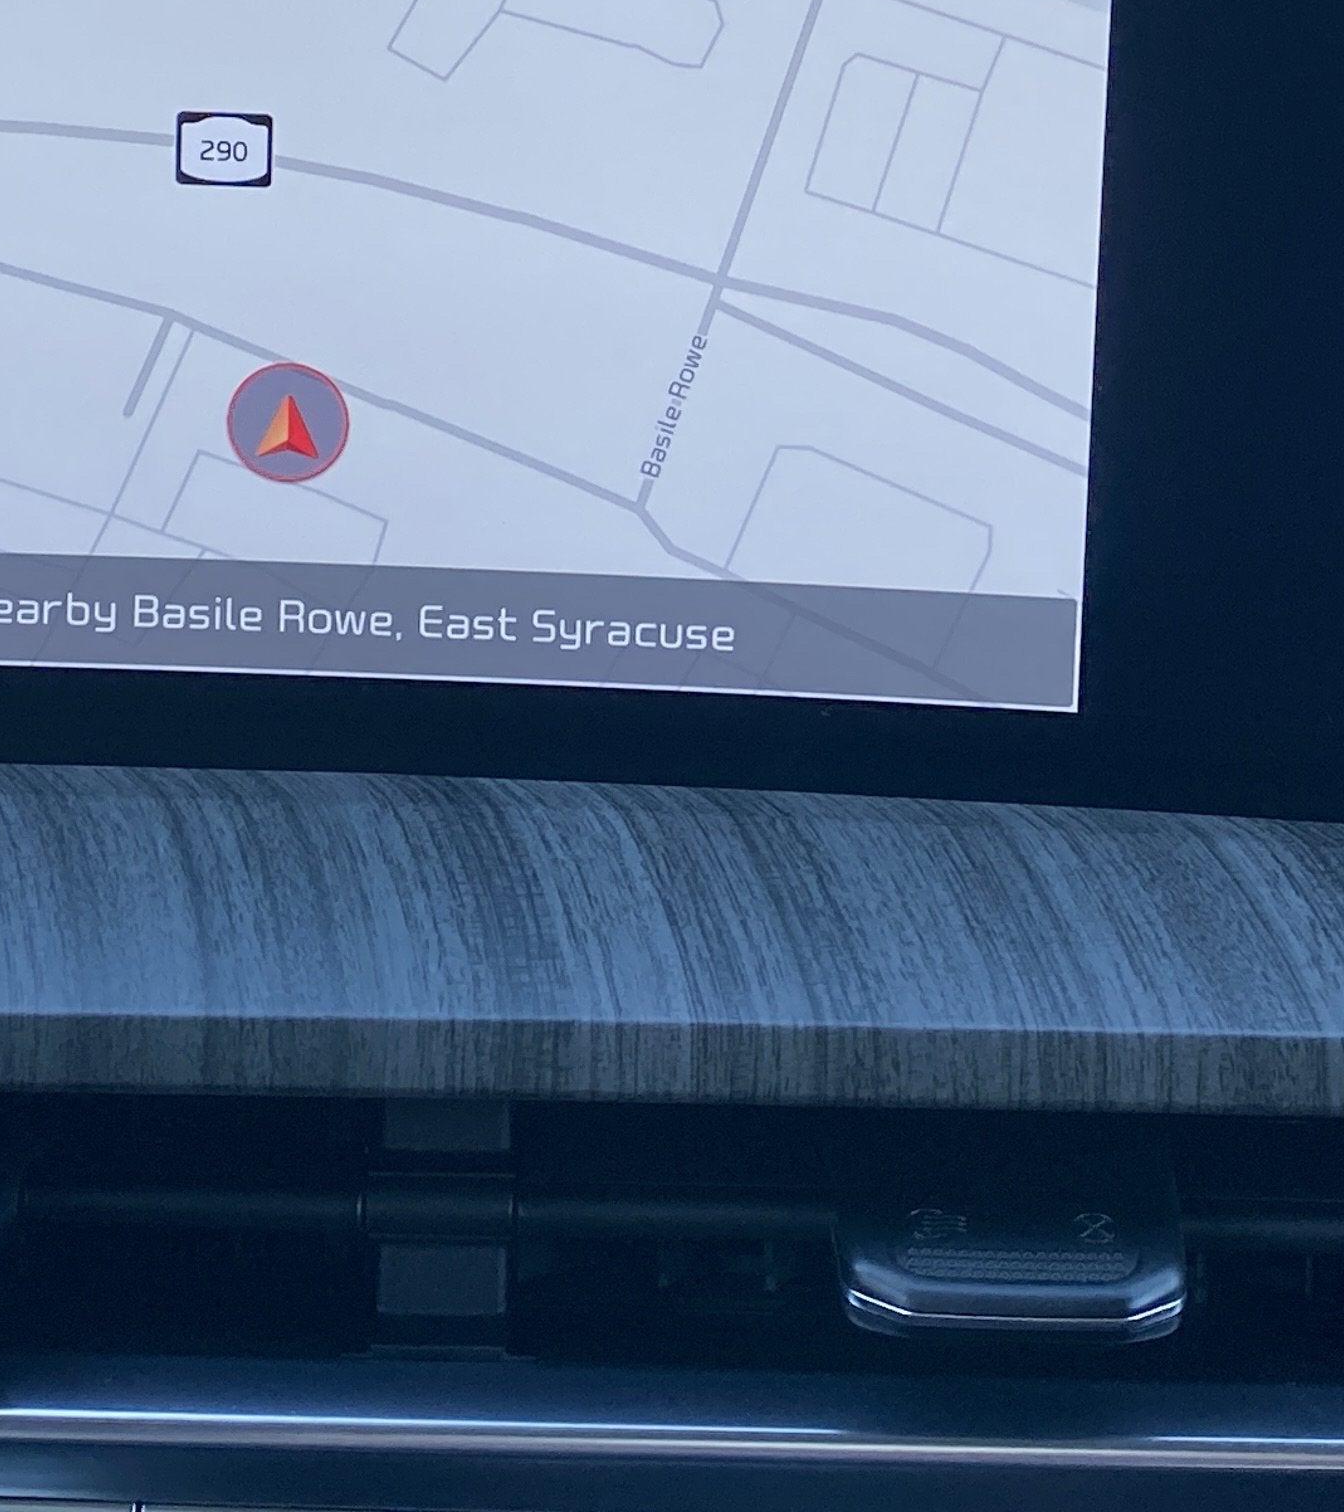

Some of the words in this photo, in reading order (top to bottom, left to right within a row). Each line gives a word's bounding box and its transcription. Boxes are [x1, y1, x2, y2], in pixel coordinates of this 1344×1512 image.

[200, 140, 248, 162] 290
[640, 406, 682, 478] Basile
[668, 335, 707, 399] Rowe
[133, 595, 262, 632] Basile
[279, 600, 403, 642] Rowe,
[418, 604, 517, 642] East
[532, 609, 736, 651] Syracuse
